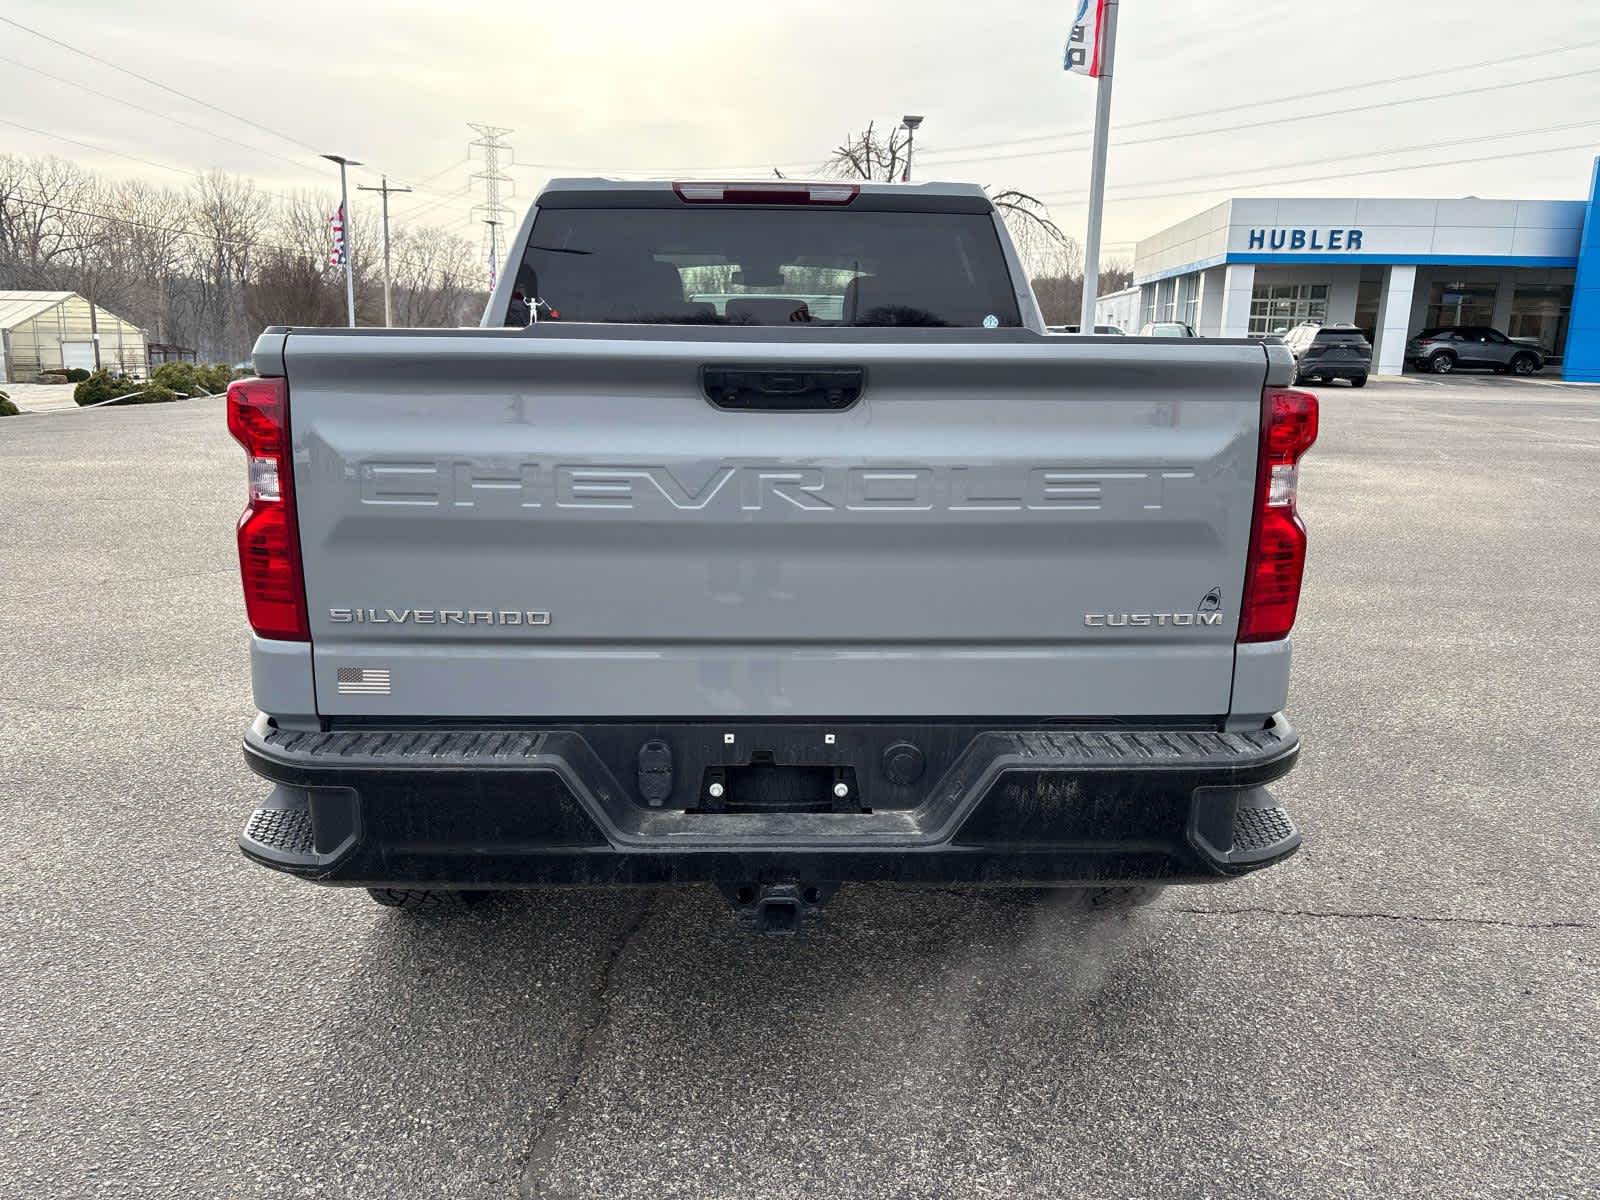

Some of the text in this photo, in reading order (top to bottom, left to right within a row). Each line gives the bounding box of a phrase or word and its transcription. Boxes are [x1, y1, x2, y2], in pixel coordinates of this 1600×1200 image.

[1249, 229, 1364, 251] HUBLER
[360, 462, 1196, 510] CHEVROLET
[328, 608, 552, 625] SILVERADO
[1084, 613, 1224, 626] CUSTOM
